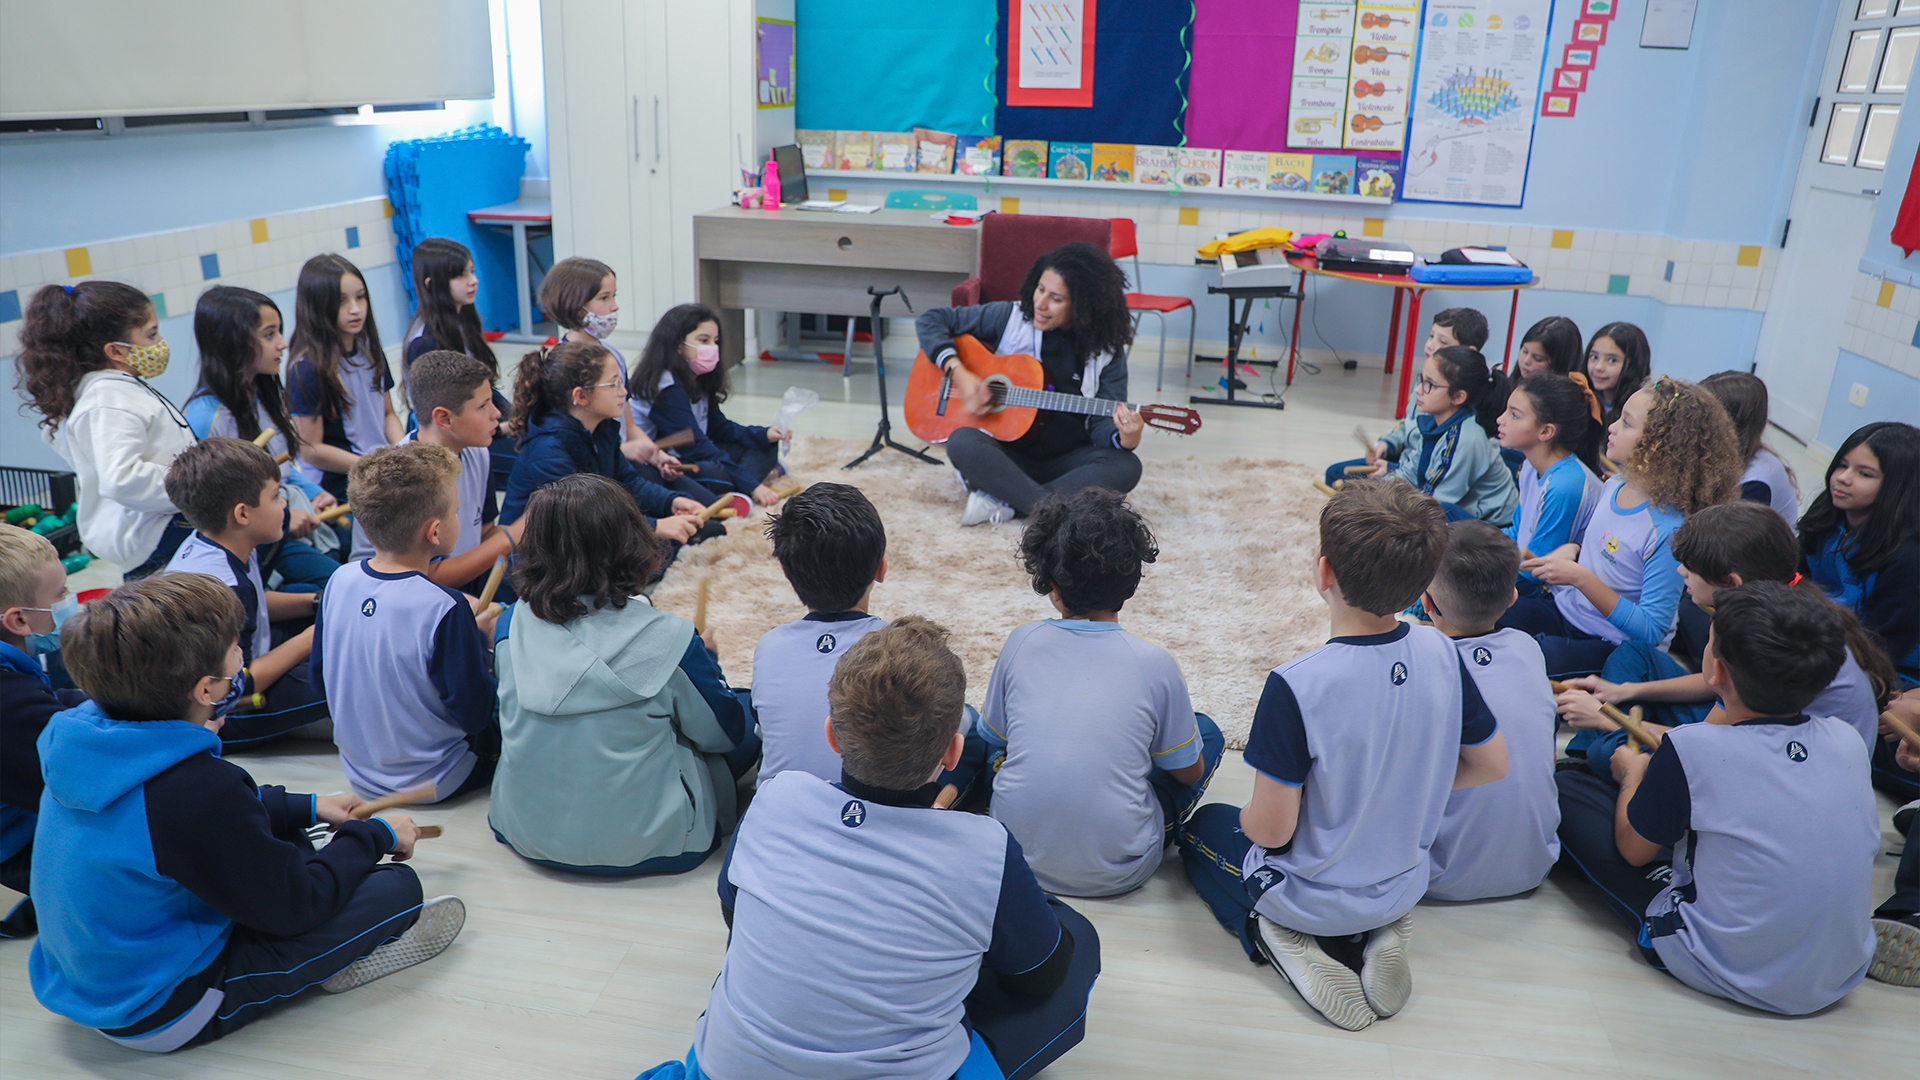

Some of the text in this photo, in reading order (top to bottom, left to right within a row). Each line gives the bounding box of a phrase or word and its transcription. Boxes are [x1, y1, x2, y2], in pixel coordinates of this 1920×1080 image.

[1370, 32, 1398, 42] Violino
[1370, 67, 1391, 76] Viola
[1300, 98, 1337, 108] Trombone
[1305, 137, 1324, 146] Tuba
[1135, 155, 1177, 168] BRAHMS
[1178, 155, 1220, 169] CHOPIN
[1275, 157, 1305, 168] BACH
